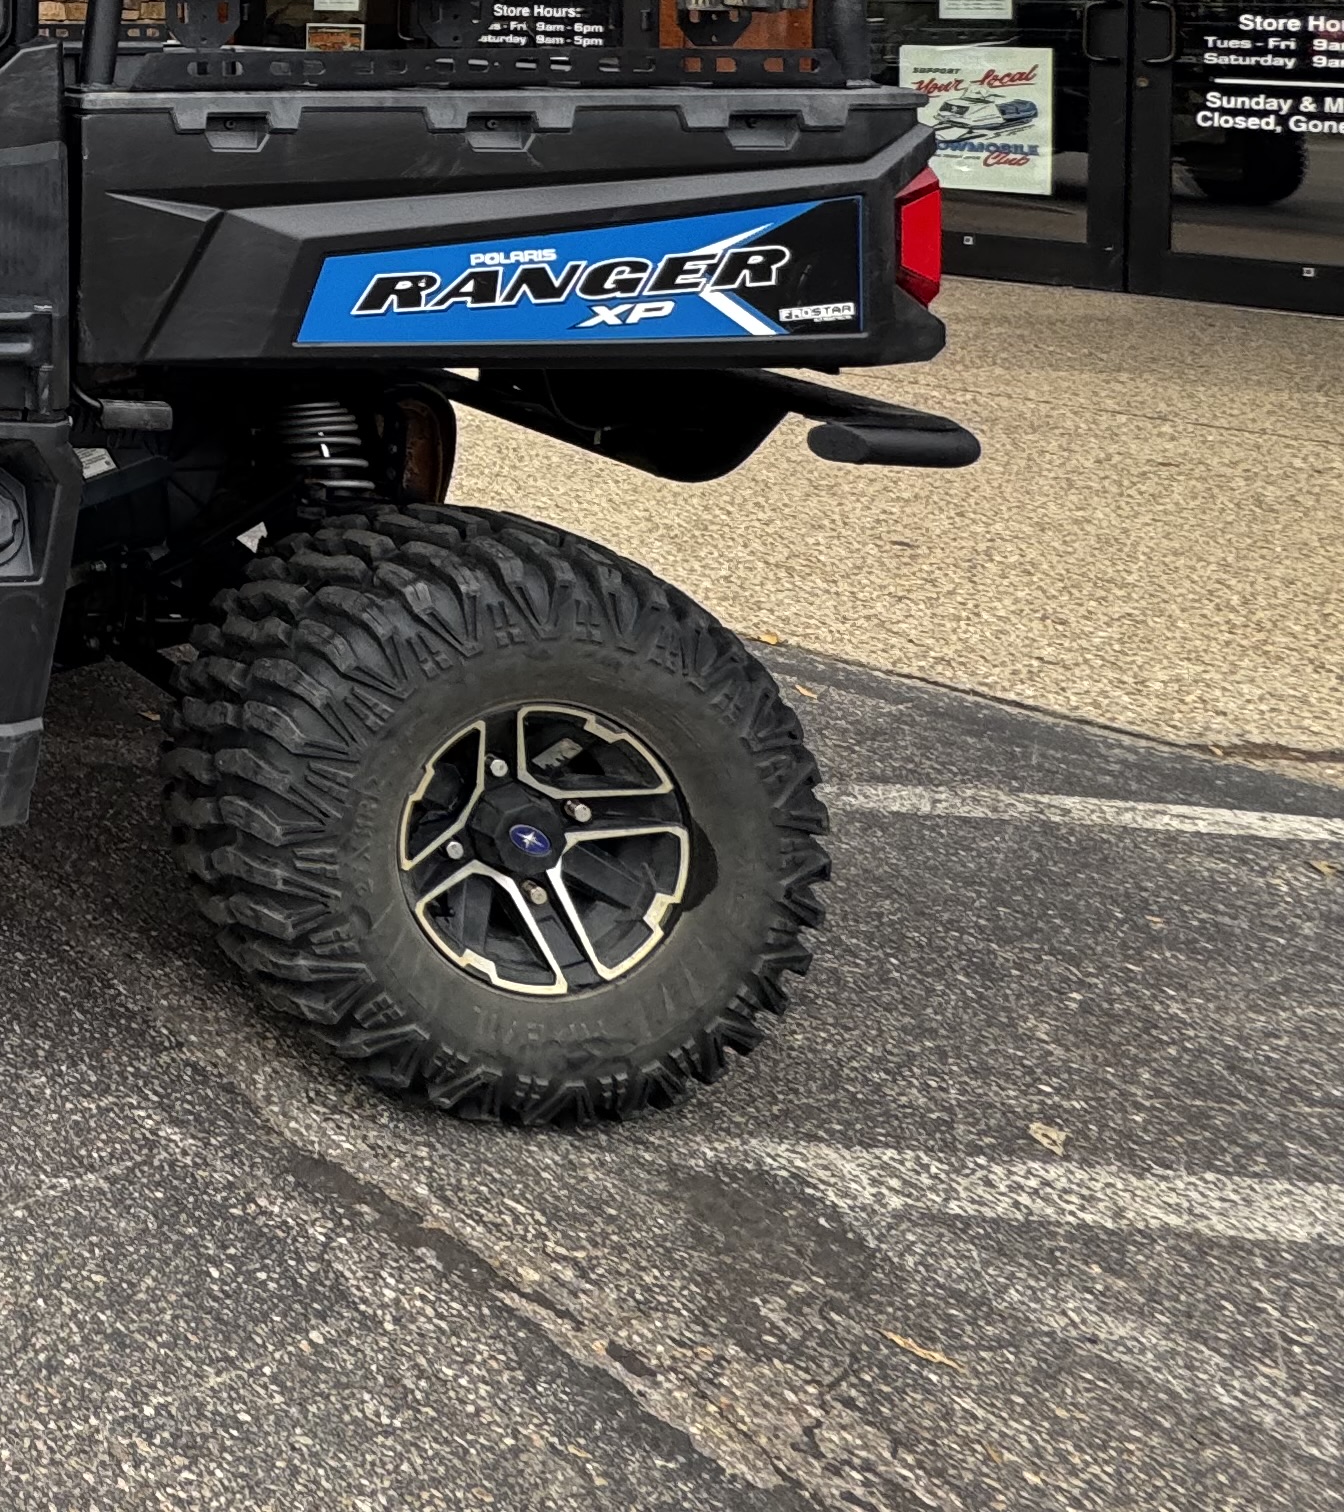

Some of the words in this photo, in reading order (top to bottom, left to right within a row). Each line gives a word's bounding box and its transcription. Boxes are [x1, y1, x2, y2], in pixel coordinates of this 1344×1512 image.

[493, 4, 530, 17] Store
[533, 5, 581, 17] Hours:
[1238, 14, 1302, 31] Store
[1308, 15, 1344, 32] Ho
[573, 35, 604, 47] 5pm
[1203, 36, 1252, 49] Tues
[1267, 38, 1297, 50] Fri
[1312, 38, 1344, 51] 9a
[1203, 52, 1297, 69] Saturday
[1311, 55, 1344, 68] 9a
[1205, 91, 1294, 115] Sunday
[1298, 96, 1318, 113] &
[1195, 111, 1283, 134] Closed,
[936, 141, 1040, 156] OWMOBILE
[470, 249, 557, 266] POLARIS
[350, 245, 790, 316] RANGER
[568, 301, 675, 329] XP
